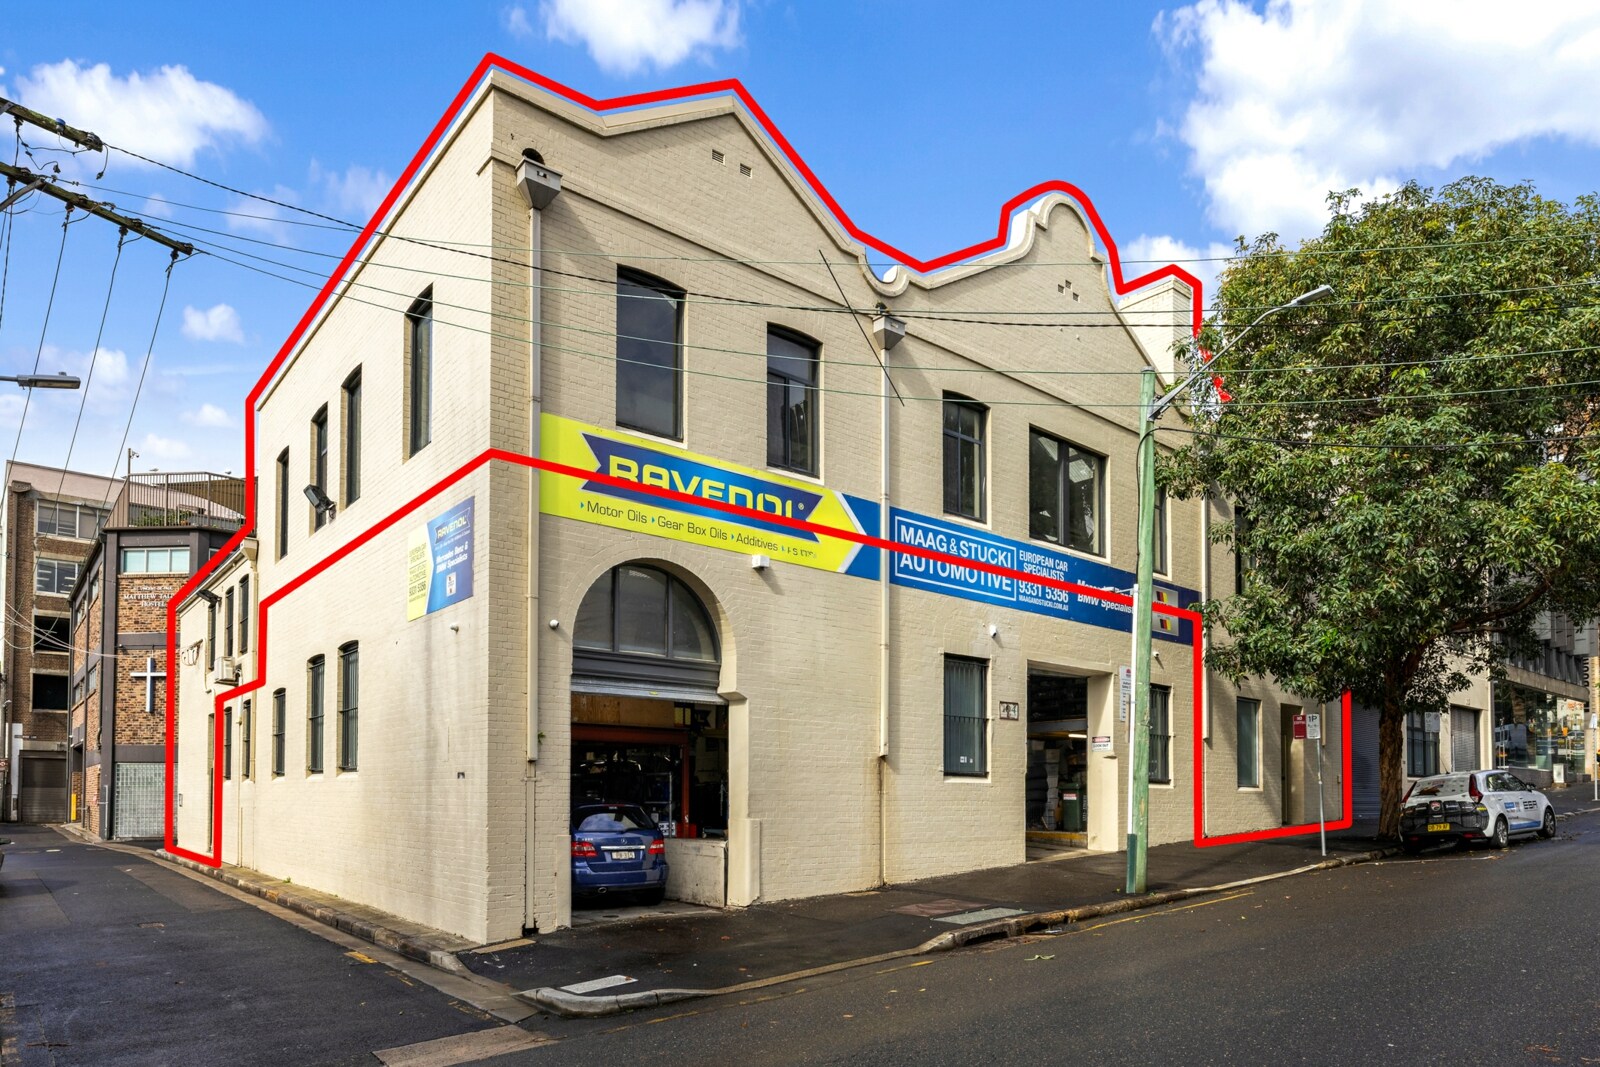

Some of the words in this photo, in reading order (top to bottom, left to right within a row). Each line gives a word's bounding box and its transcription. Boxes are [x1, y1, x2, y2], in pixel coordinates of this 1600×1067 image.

[437, 516, 467, 539] RAVENOL
[587, 501, 623, 518] Motor
[627, 509, 647, 524] Oils
[657, 515, 684, 531] Gear
[687, 522, 706, 536] Box
[709, 527, 728, 541] Oils
[736, 533, 778, 551] Additives
[900, 525, 947, 553] MAAG
[949, 538, 958, 555] &
[959, 540, 1011, 568] STUCKI
[900, 553, 1011, 591] AUTOMOTIVE
[1019, 550, 1054, 568] EUROPEAN
[1055, 559, 1068, 572] CAR
[1023, 562, 1065, 581] SPECIALISTS
[1019, 580, 1042, 597] 9331
[1045, 586, 1069, 603] 5356
[1077, 593, 1099, 606] BMW
[1101, 599, 1134, 614] Specialis
